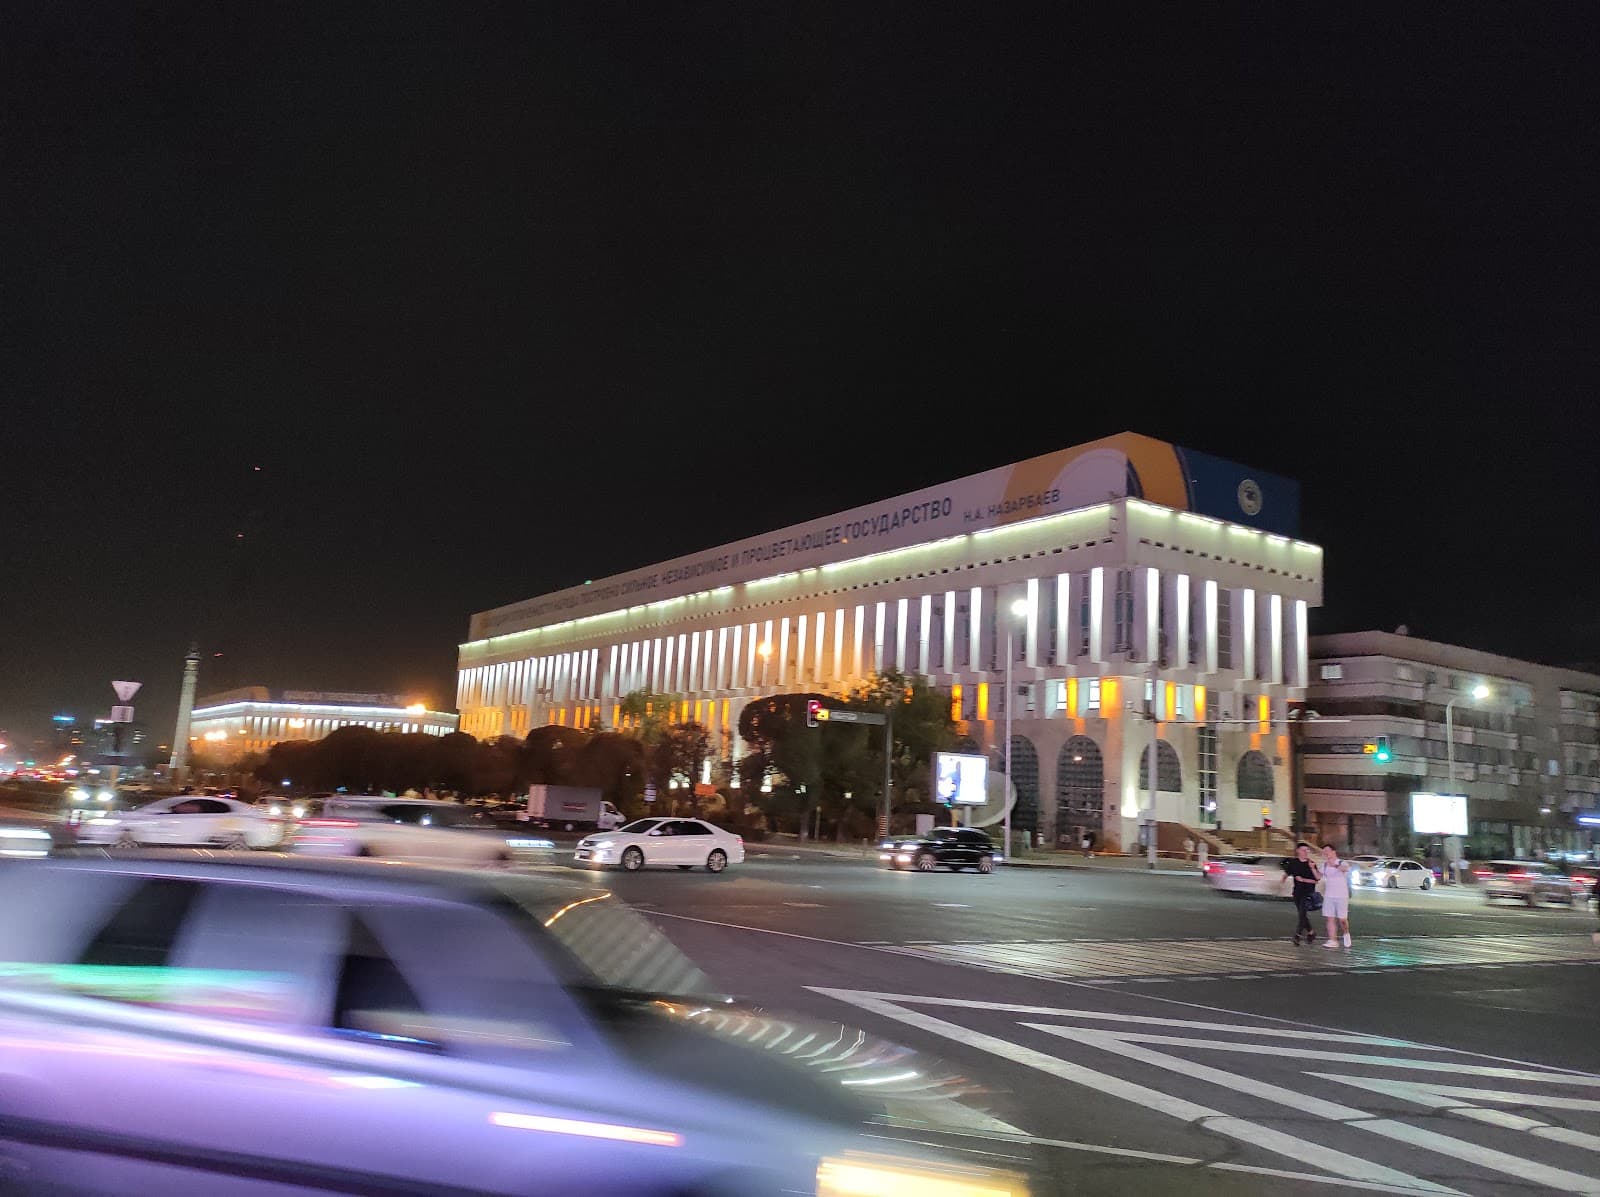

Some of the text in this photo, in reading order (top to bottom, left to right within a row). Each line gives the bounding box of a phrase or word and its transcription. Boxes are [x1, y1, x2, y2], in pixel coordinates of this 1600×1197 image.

[988, 489, 1061, 518] НАЗАРБАЕВ
[731, 552, 739, 569] И
[742, 526, 841, 565] ПРОЦВЕТАЮЩЕЕ
[845, 497, 953, 538] ГОСУДАРСТВО
